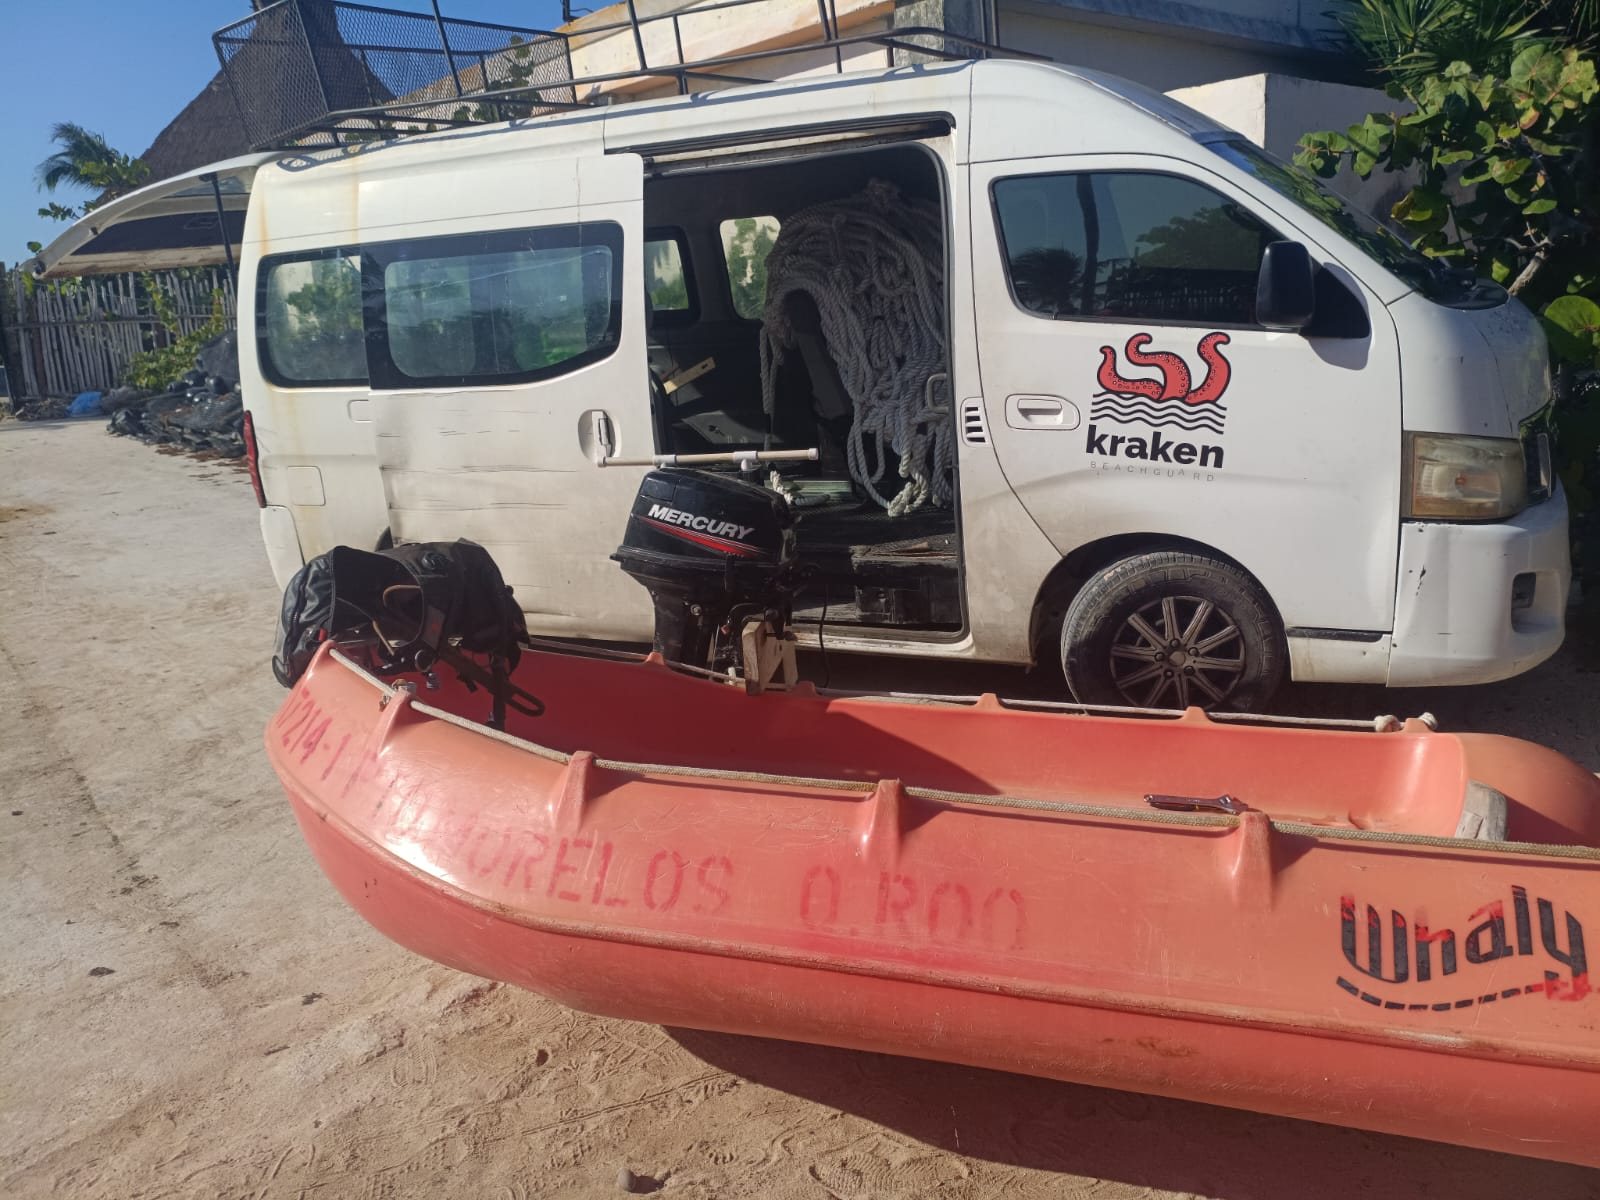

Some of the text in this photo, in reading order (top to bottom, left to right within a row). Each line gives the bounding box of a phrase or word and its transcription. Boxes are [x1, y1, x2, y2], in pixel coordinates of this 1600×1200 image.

[1086, 424, 1224, 469] kraken
[1090, 461, 1214, 482] BEACHGUARD
[648, 503, 755, 539] MERCURY
